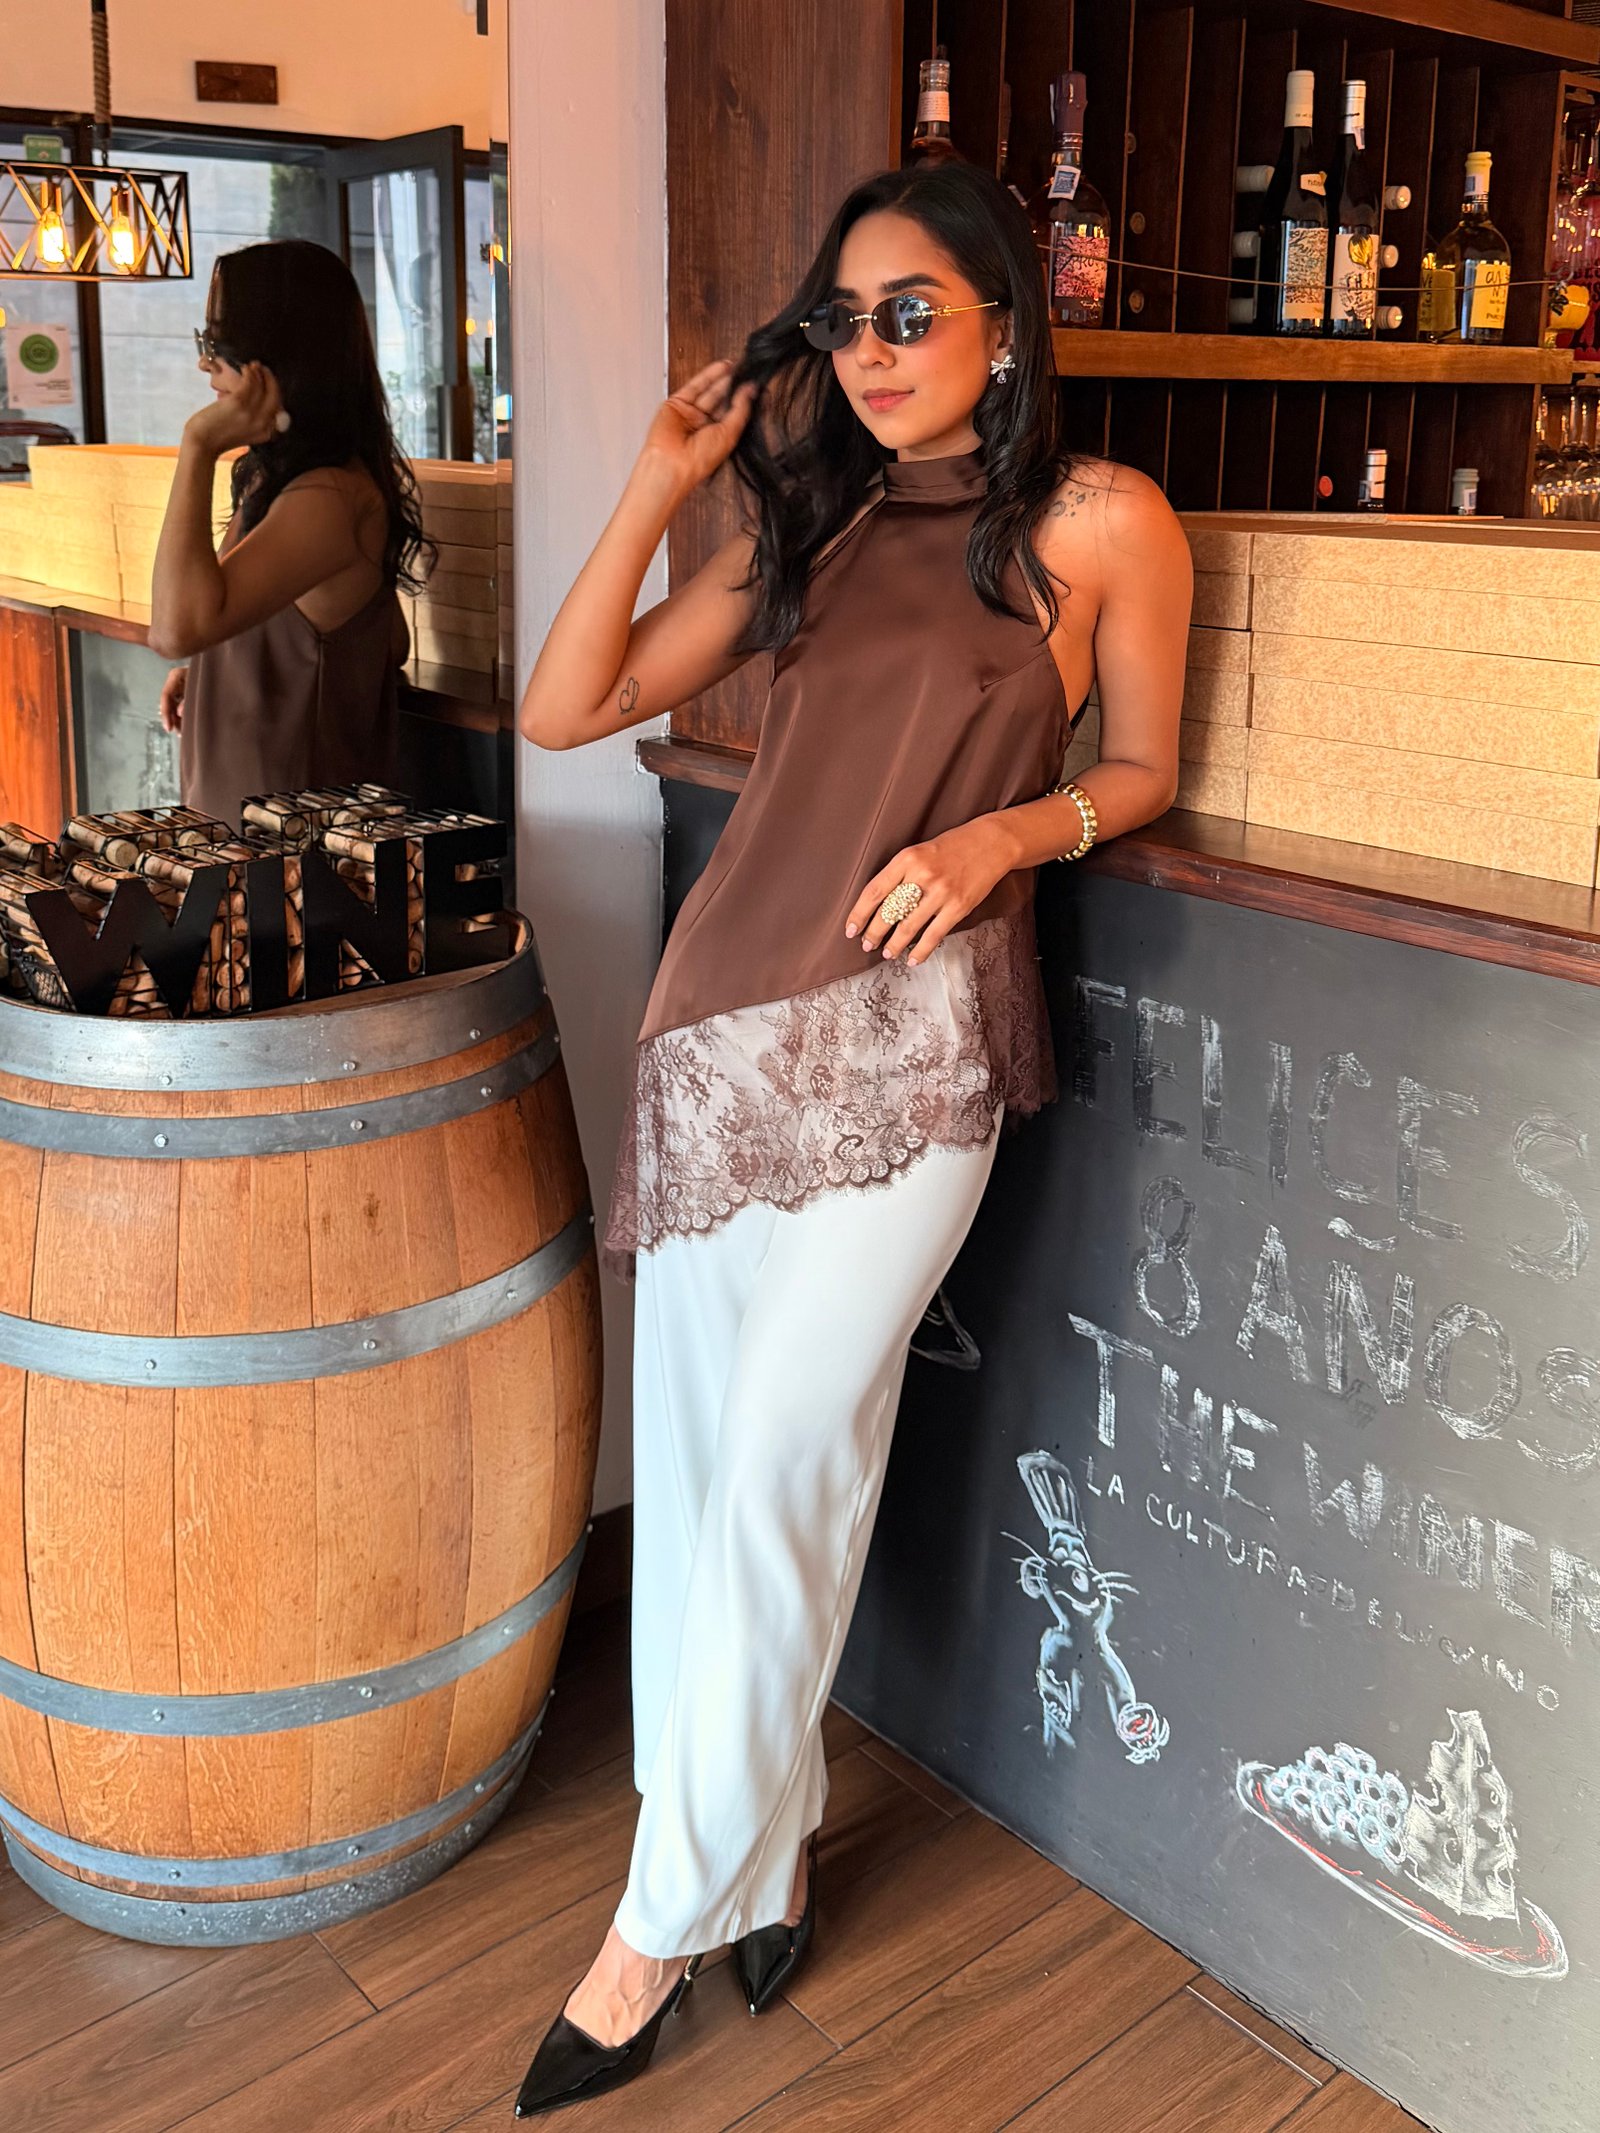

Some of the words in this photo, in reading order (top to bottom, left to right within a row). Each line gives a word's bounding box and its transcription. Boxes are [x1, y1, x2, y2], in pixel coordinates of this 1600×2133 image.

[25, 822, 507, 1018] WINE
[1073, 974, 1589, 1284] FELICES
[1067, 1312, 1279, 1523] THE
[1133, 1174, 1200, 1338] 8
[1236, 1216, 1600, 1472] AÑOS
[1086, 1455, 1125, 1505] LA
[1145, 1493, 1308, 1596] CULTURA
